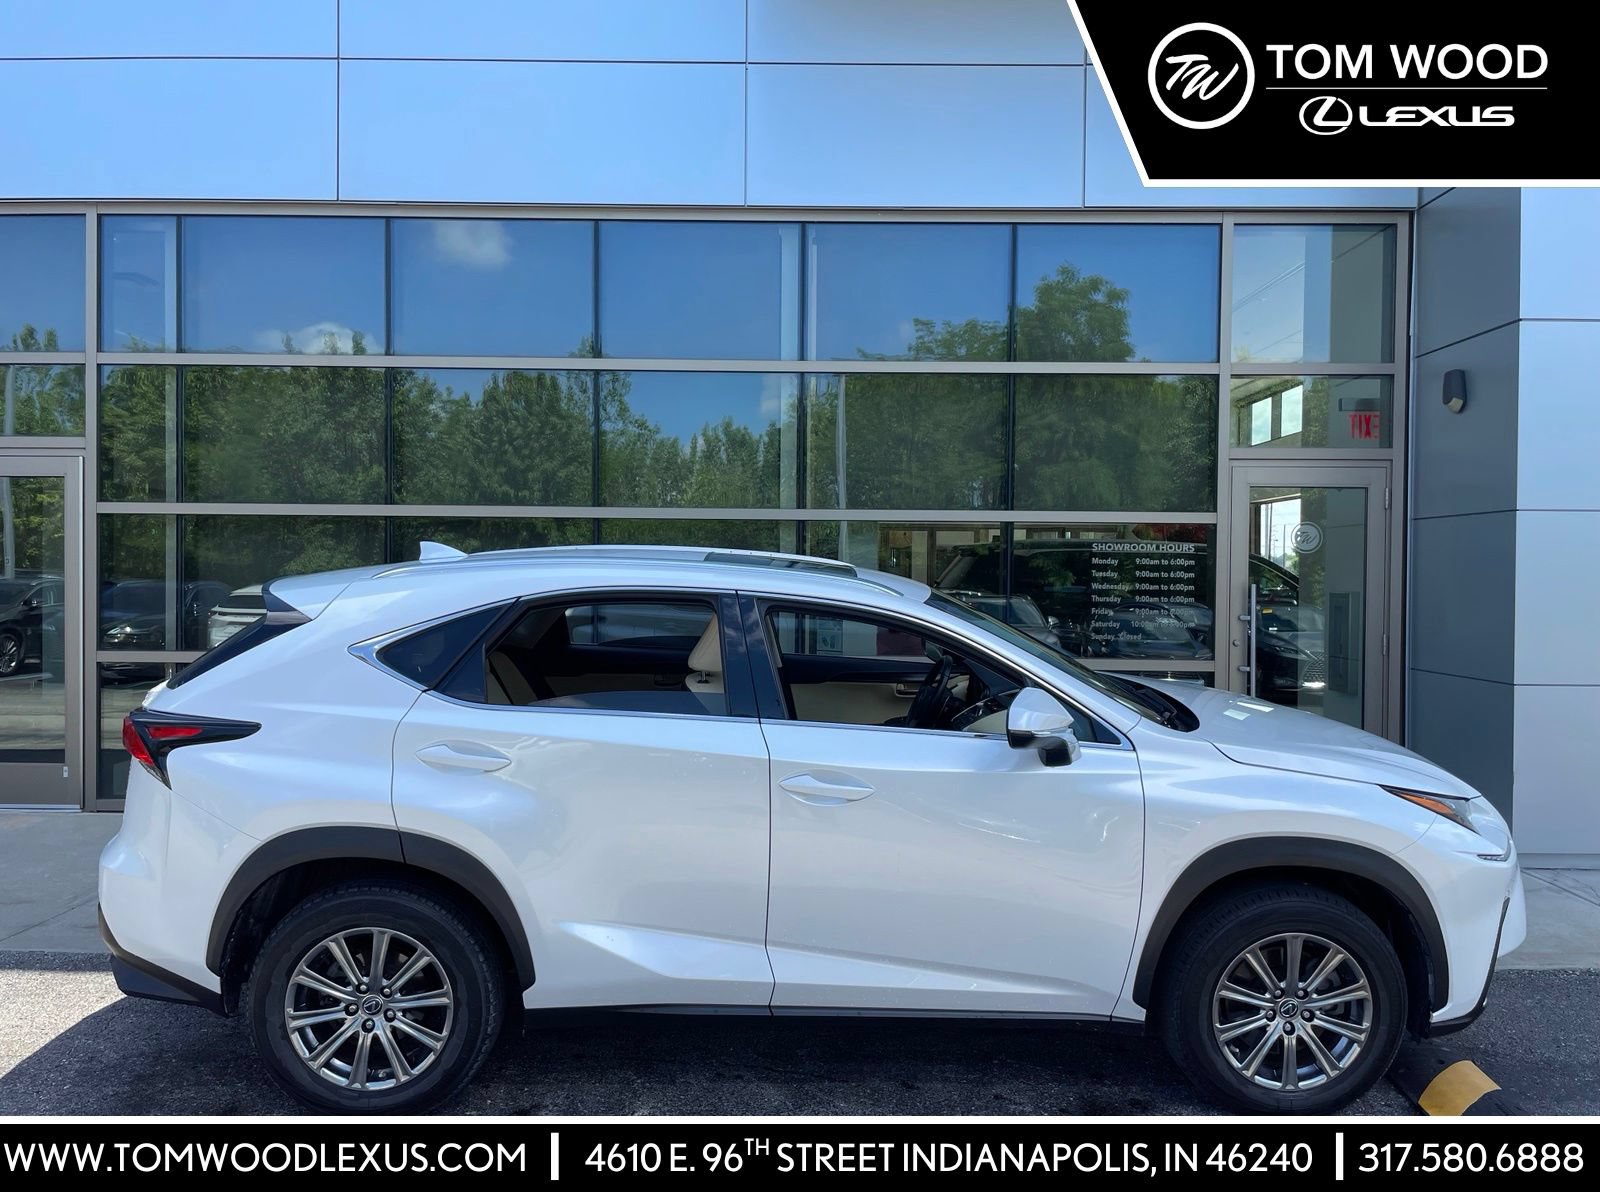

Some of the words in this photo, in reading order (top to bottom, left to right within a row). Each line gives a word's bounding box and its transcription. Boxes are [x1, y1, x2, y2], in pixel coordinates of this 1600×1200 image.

[1092, 543, 1156, 552] SHOWROOM
[1160, 544, 1195, 553] HOURS
[1091, 557, 1119, 566] Monday
[1170, 558, 1196, 567] 6:00pm
[1091, 570, 1119, 579] Tuesday
[1170, 571, 1196, 579] 6:00pm
[1091, 583, 1128, 591] Wednesday
[1170, 583, 1195, 592] 6:00pm
[1091, 595, 1121, 604] Thursday
[1170, 596, 1195, 604] 6:00pm
[1091, 608, 1113, 616] Friday
[1091, 620, 1121, 629] Saturday
